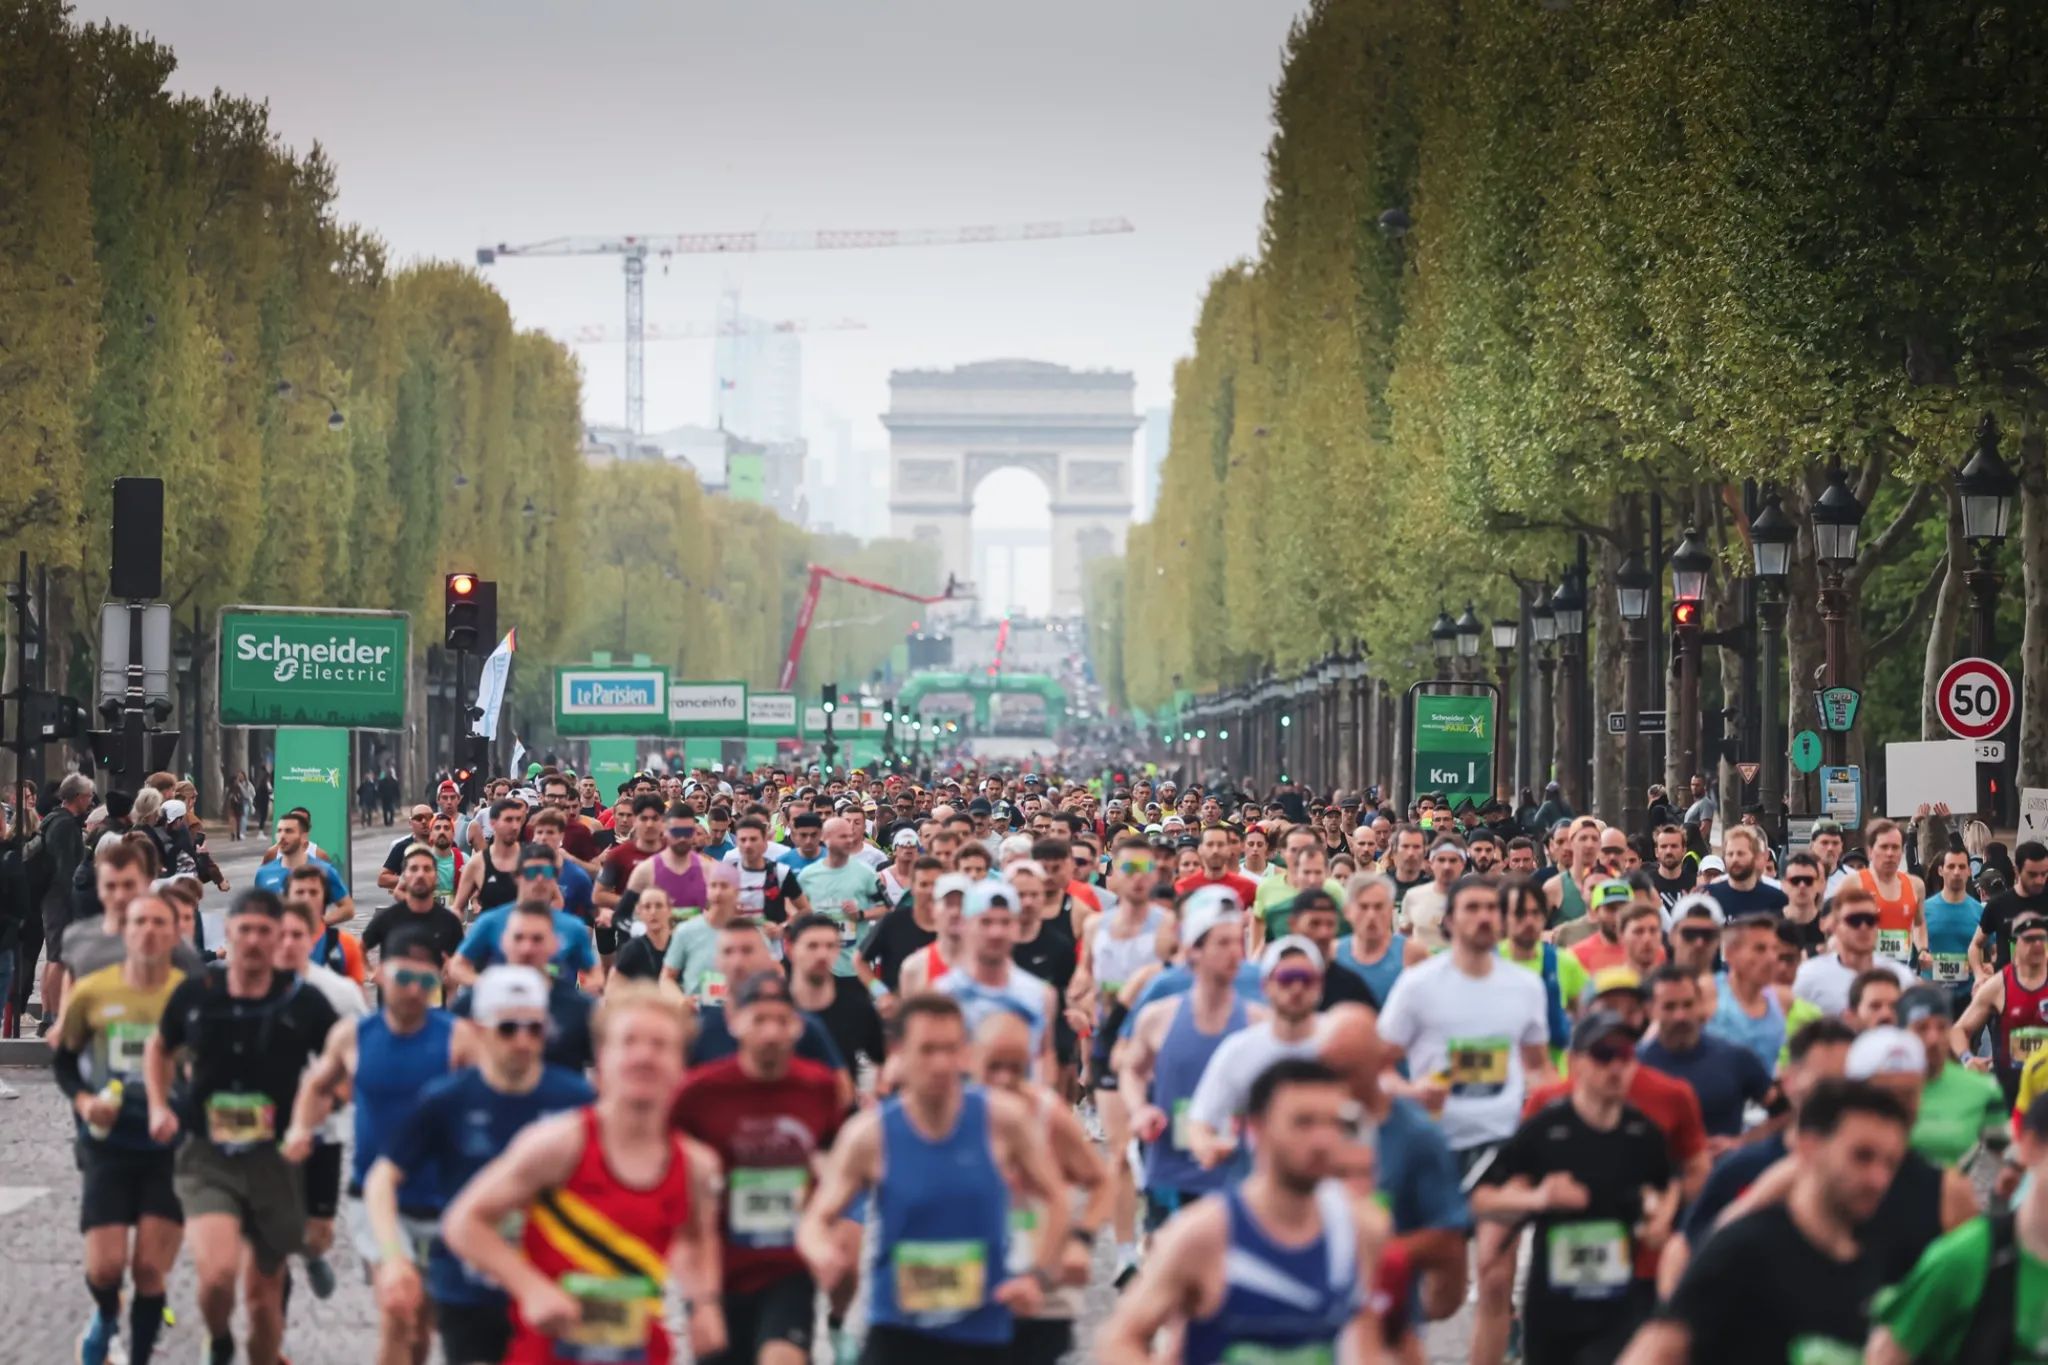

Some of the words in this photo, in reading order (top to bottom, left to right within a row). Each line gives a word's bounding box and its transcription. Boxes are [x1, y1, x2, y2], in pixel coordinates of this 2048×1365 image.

[237, 633, 390, 664] Schneider
[302, 663, 386, 682] Electric
[577, 687, 591, 704] Le
[592, 682, 648, 704] Parisien
[1953, 684, 1997, 716] 50
[1431, 713, 1465, 721] Schneider
[1982, 746, 1999, 757] 50
[1430, 768, 1459, 783] Km
